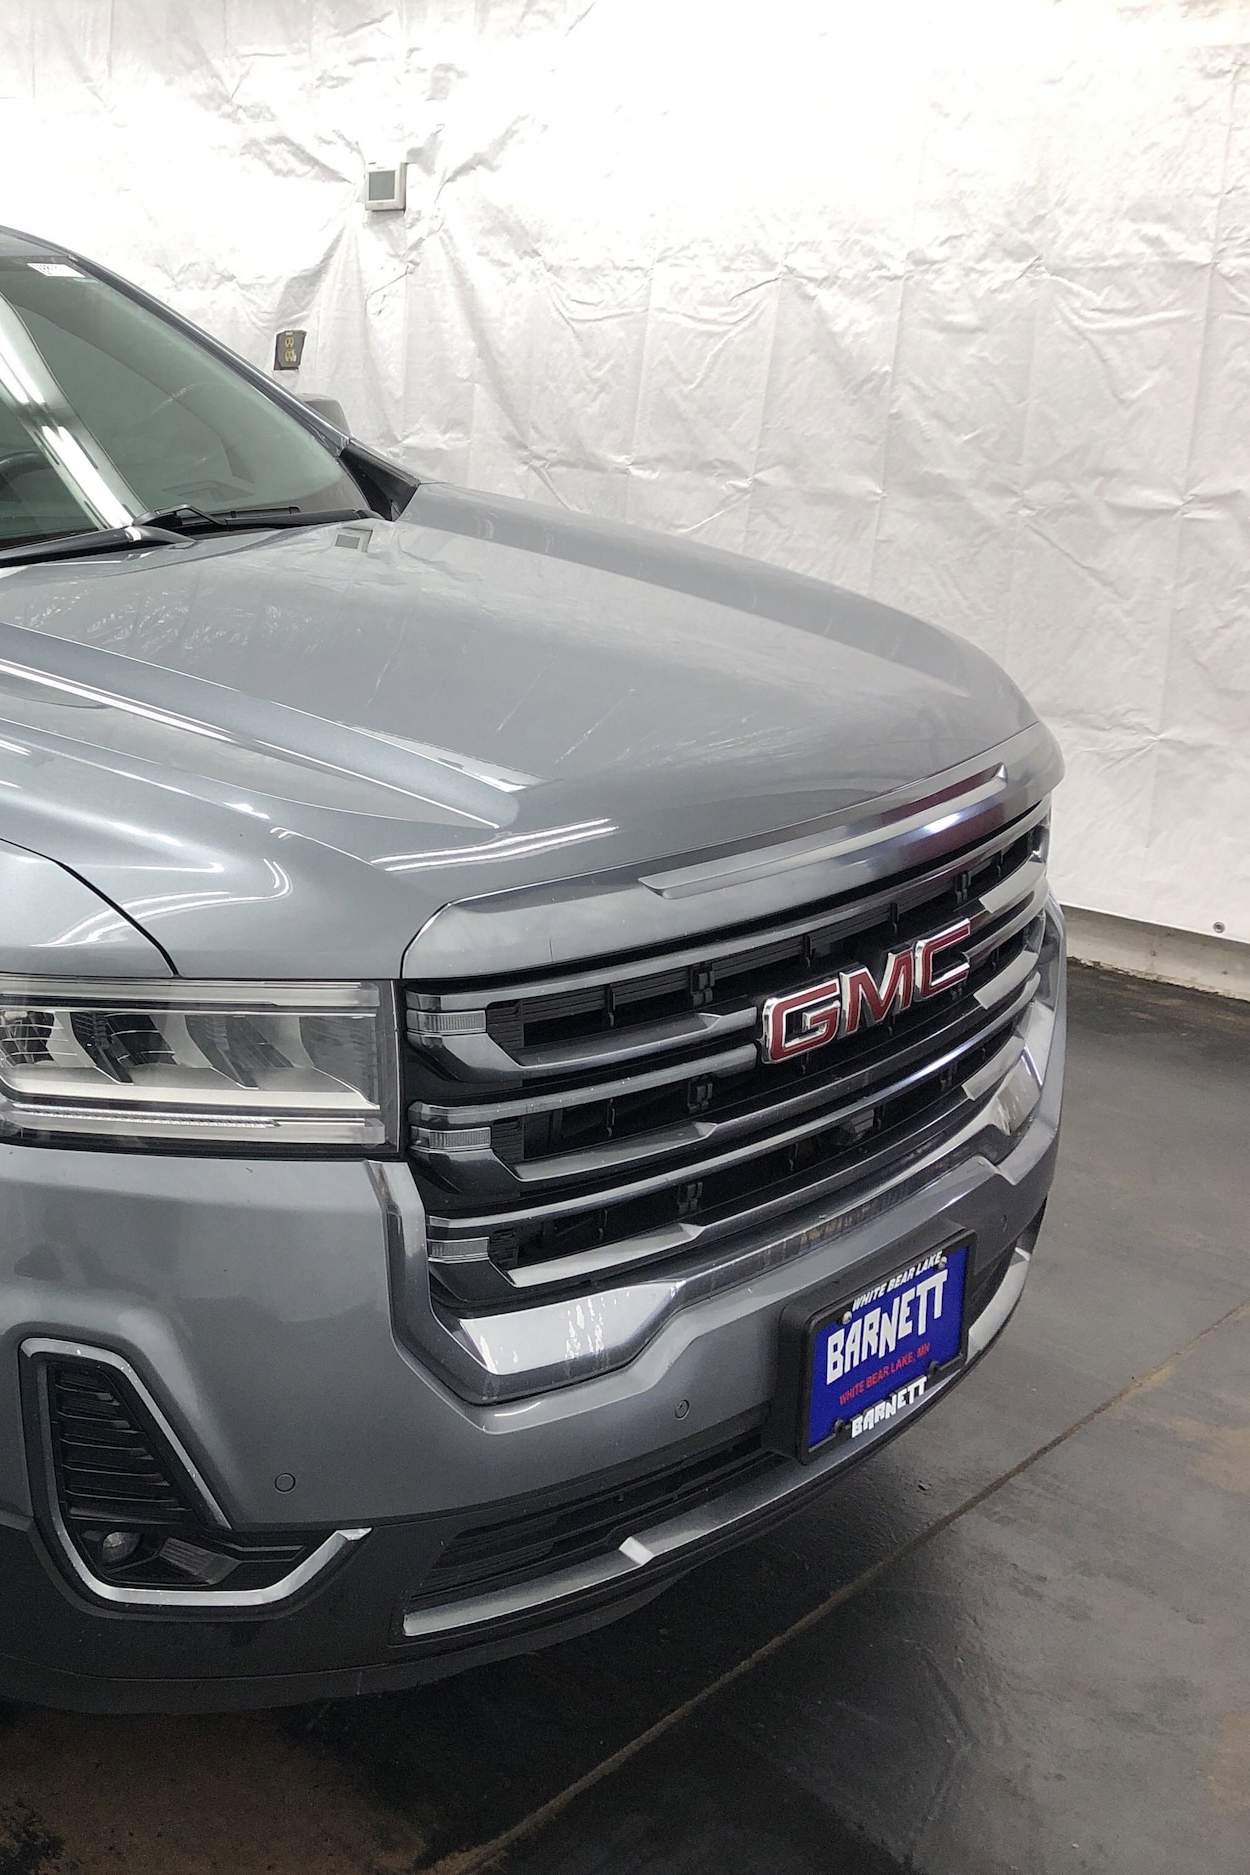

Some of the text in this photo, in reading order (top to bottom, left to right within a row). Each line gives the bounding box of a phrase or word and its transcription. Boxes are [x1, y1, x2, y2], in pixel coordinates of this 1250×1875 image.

[761, 917, 971, 1064] GMC
[852, 1250, 942, 1312] WHITE BEAR LAKE
[826, 1268, 948, 1385] BARNETT
[839, 1380, 865, 1406] WHITE
[865, 1364, 890, 1389] BEAR
[917, 1342, 930, 1359] MN
[852, 1375, 927, 1438] BARNETT
